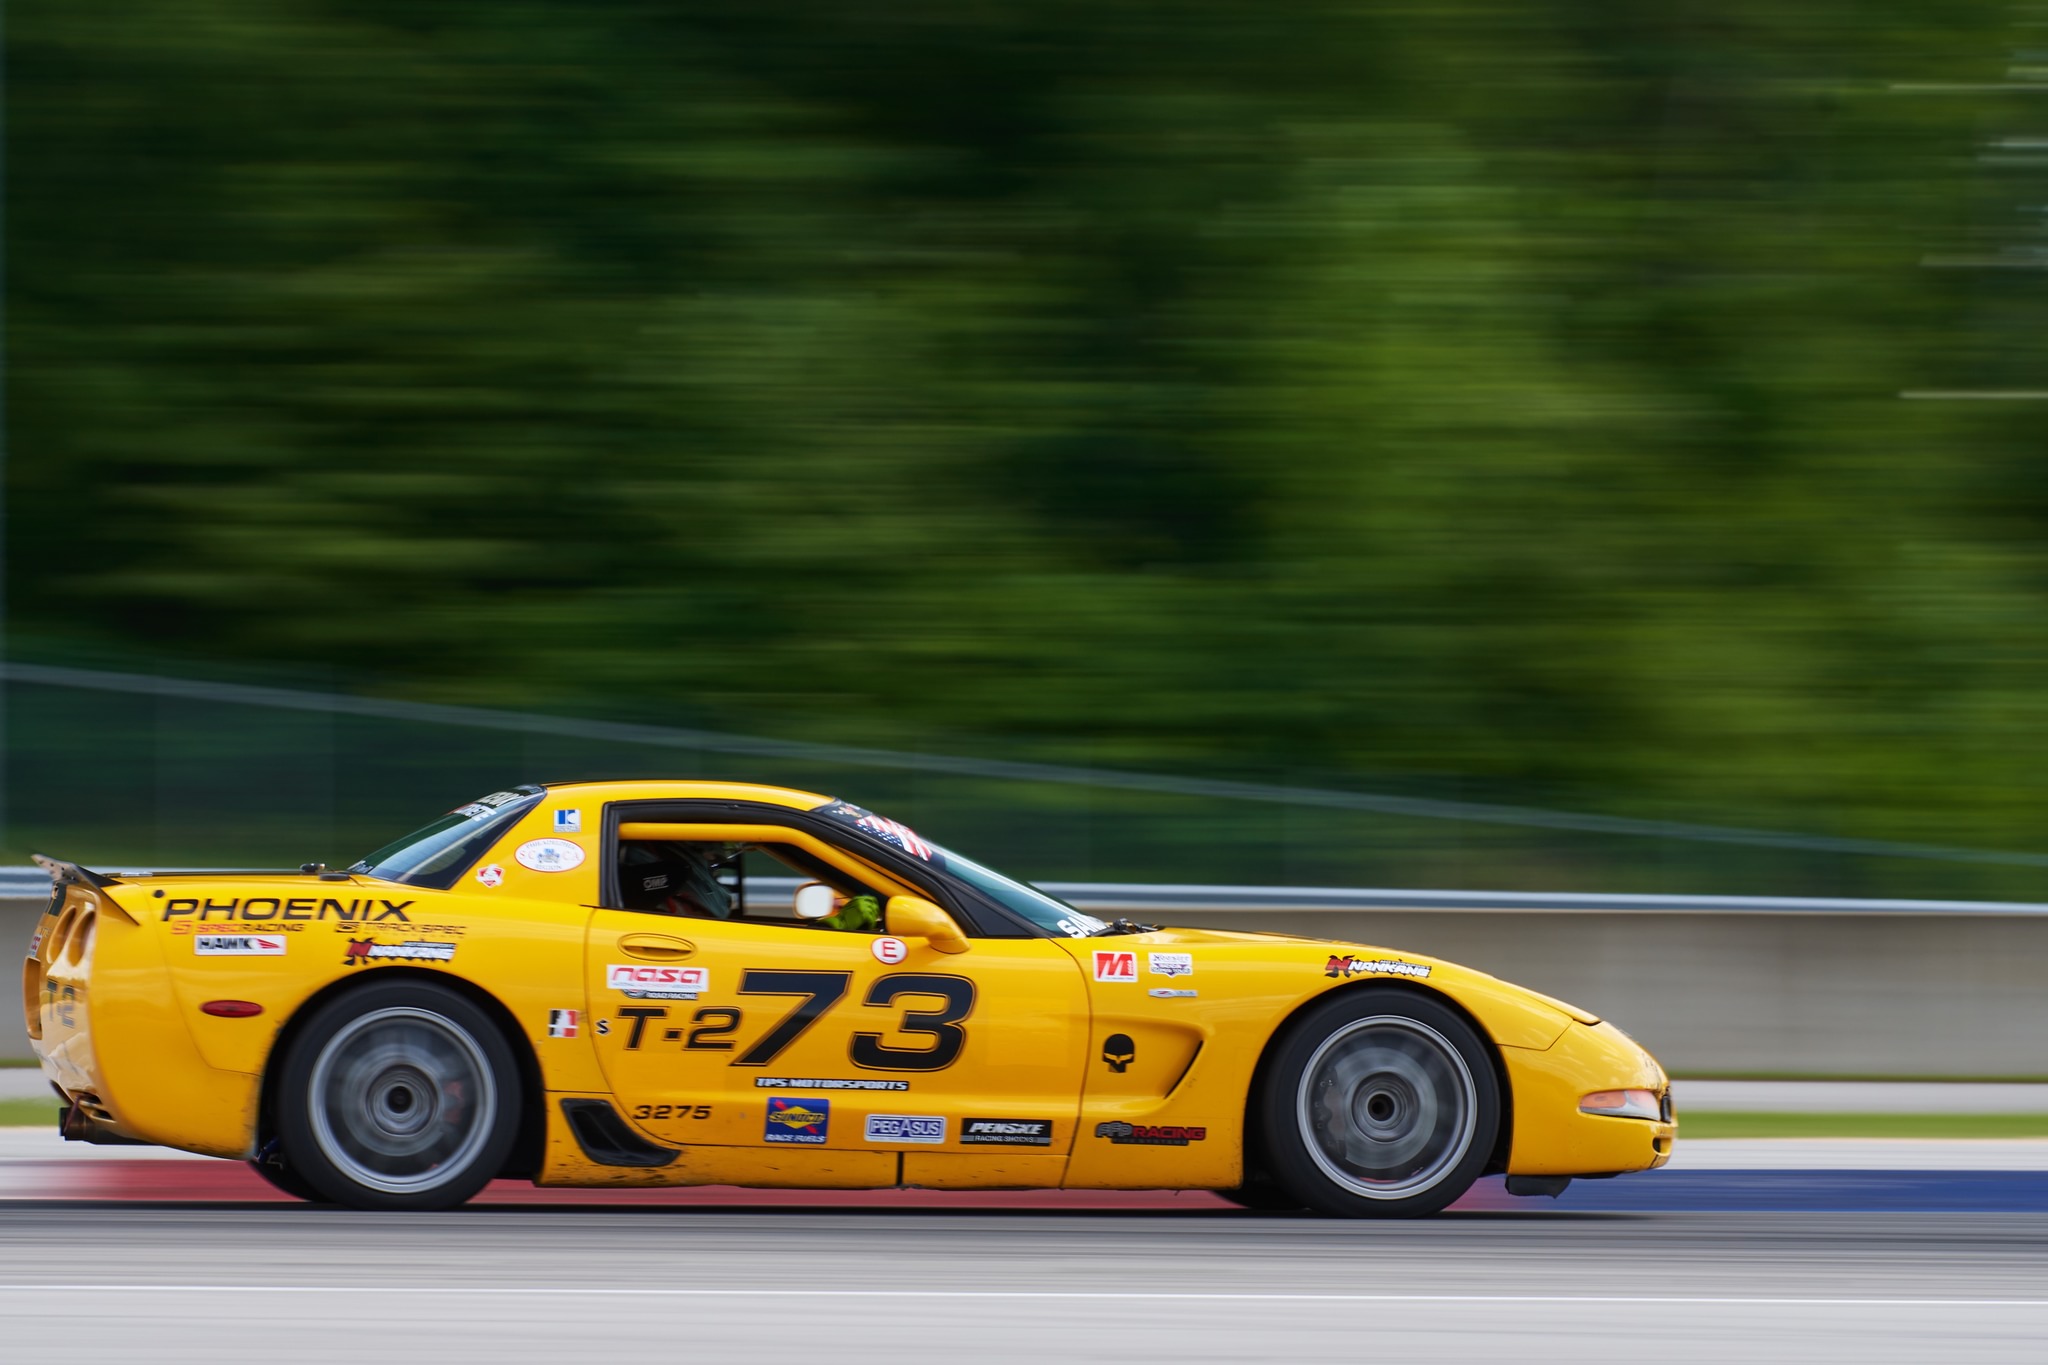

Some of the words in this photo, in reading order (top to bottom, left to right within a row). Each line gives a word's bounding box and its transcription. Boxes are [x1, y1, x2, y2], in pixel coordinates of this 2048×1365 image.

[160, 897, 416, 922] PHOENIX
[197, 936, 253, 950] HAWK
[882, 941, 897, 958] E
[1348, 960, 1430, 977] NANKANG
[728, 967, 977, 1073] 73
[756, 1077, 789, 1087] TPS
[790, 1079, 908, 1090] MOTORSPORTS
[633, 1105, 712, 1120] 3275
[771, 1112, 826, 1123] SUNOCO
[871, 1118, 941, 1136] PEGASUS
[969, 1122, 1045, 1135] PENSKE
[1133, 1126, 1206, 1140] RACING
[765, 1134, 794, 1142] RACE
[795, 1134, 826, 1143] FUELS
